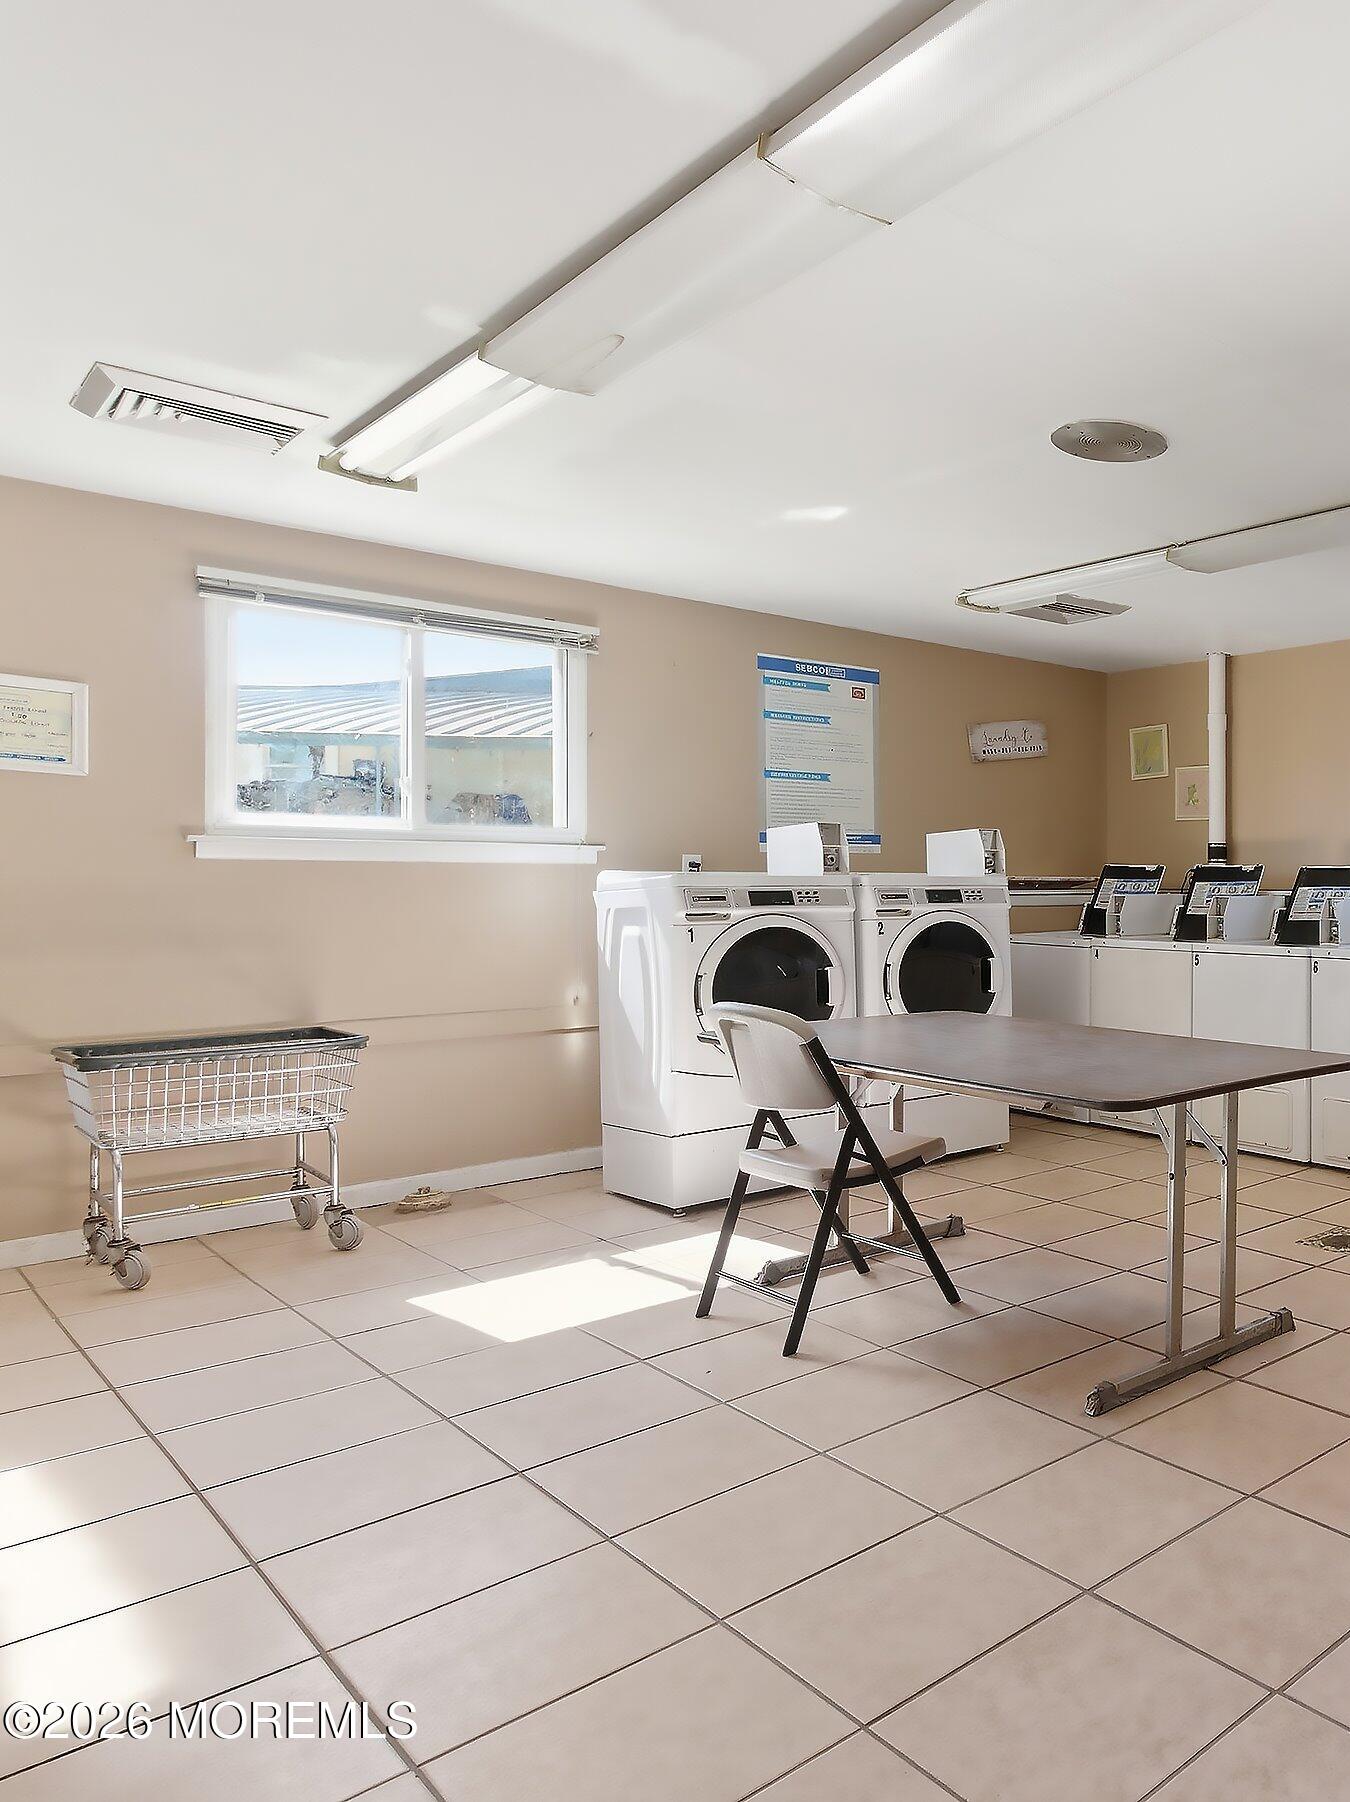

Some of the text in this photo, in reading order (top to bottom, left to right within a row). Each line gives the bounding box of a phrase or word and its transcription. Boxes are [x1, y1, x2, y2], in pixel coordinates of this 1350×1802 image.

[795, 663, 826, 675] SEBCO
[878, 922, 884, 935] 2
[688, 928, 694, 942] 1
[1194, 954, 1200, 966] 5
[1313, 961, 1319, 973] 6
